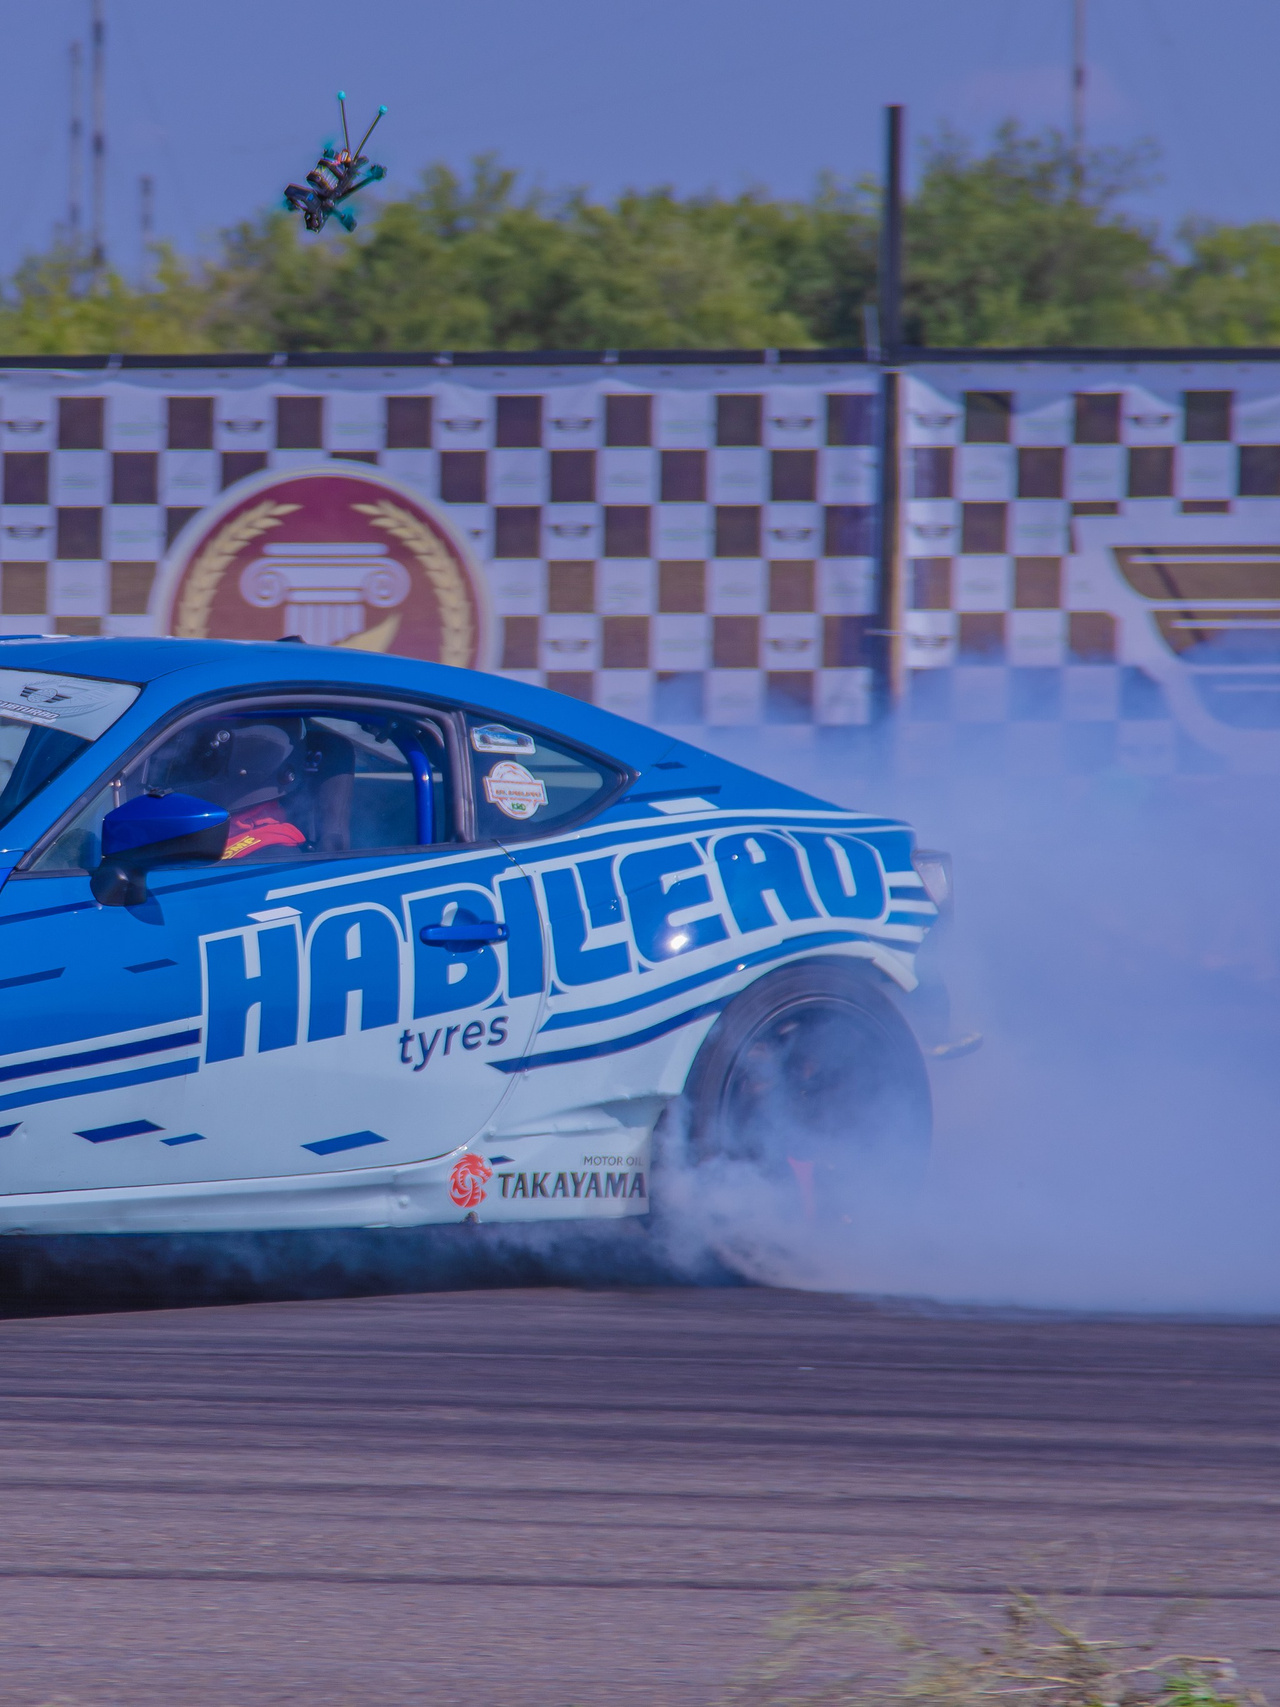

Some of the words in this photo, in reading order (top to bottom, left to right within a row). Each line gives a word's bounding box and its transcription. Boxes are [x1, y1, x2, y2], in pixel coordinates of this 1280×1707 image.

[203, 831, 887, 1064] HABILEAD
[398, 1015, 509, 1072] tyres
[583, 1155, 623, 1167] MOTOR
[626, 1156, 644, 1167] OIL
[498, 1171, 648, 1199] TAKAYAMA
